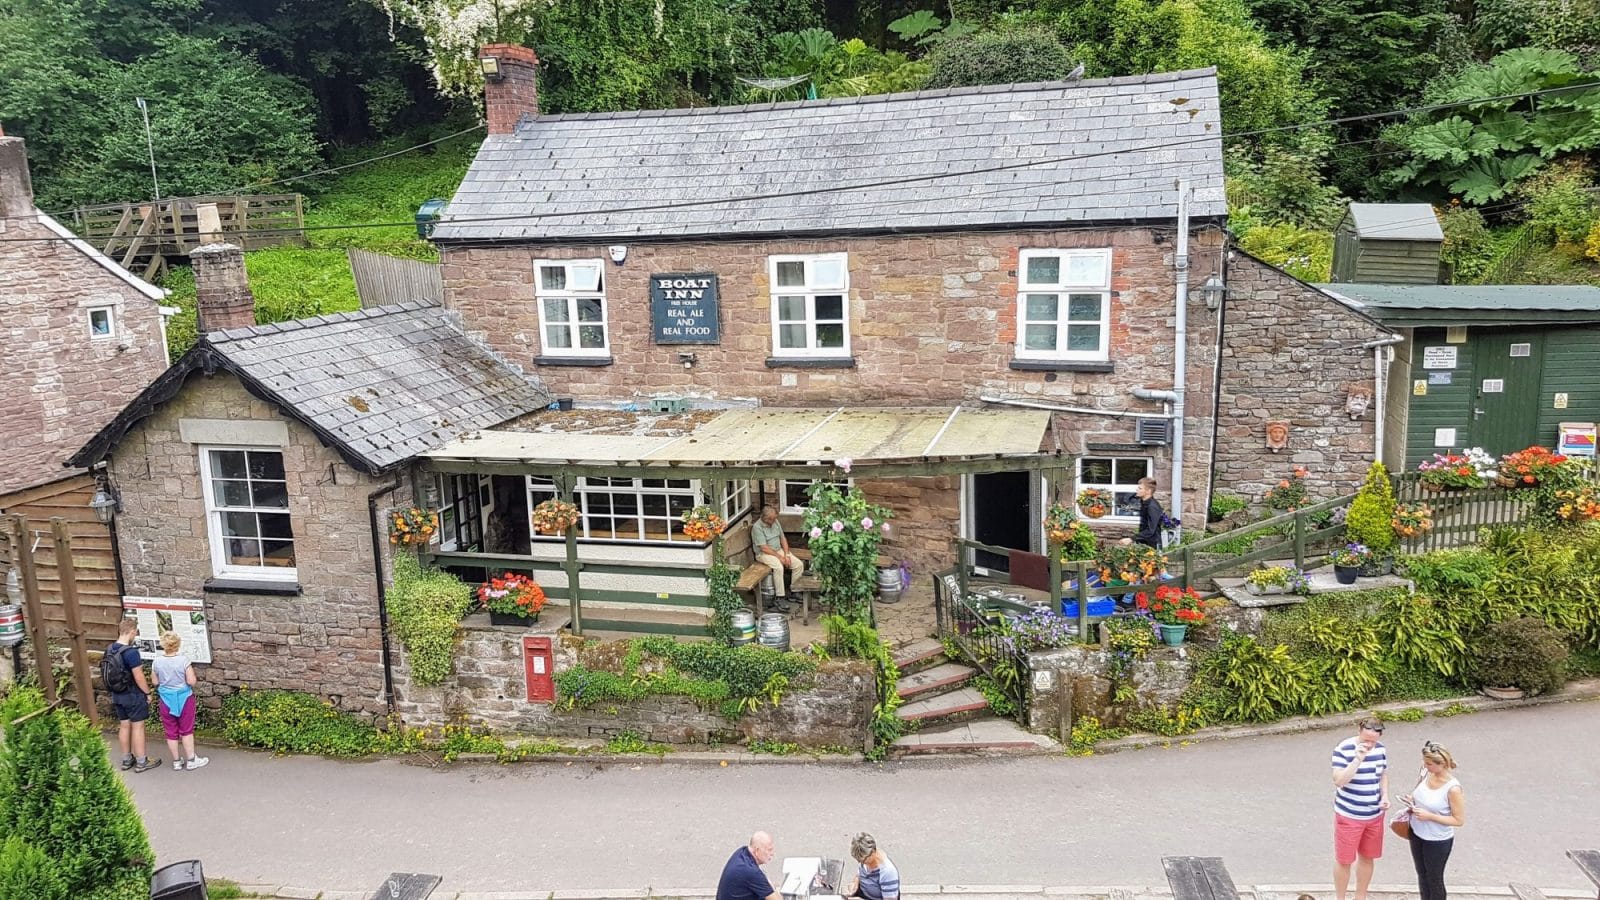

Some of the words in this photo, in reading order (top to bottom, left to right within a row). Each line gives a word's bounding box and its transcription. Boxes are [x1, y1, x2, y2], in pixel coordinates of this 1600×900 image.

[658, 279, 711, 289] BOAT
[664, 289, 704, 299] INN
[667, 309, 686, 317] REAL
[690, 309, 704, 317] ALE
[662, 327, 682, 335] REAL
[685, 327, 710, 335] FOOD
